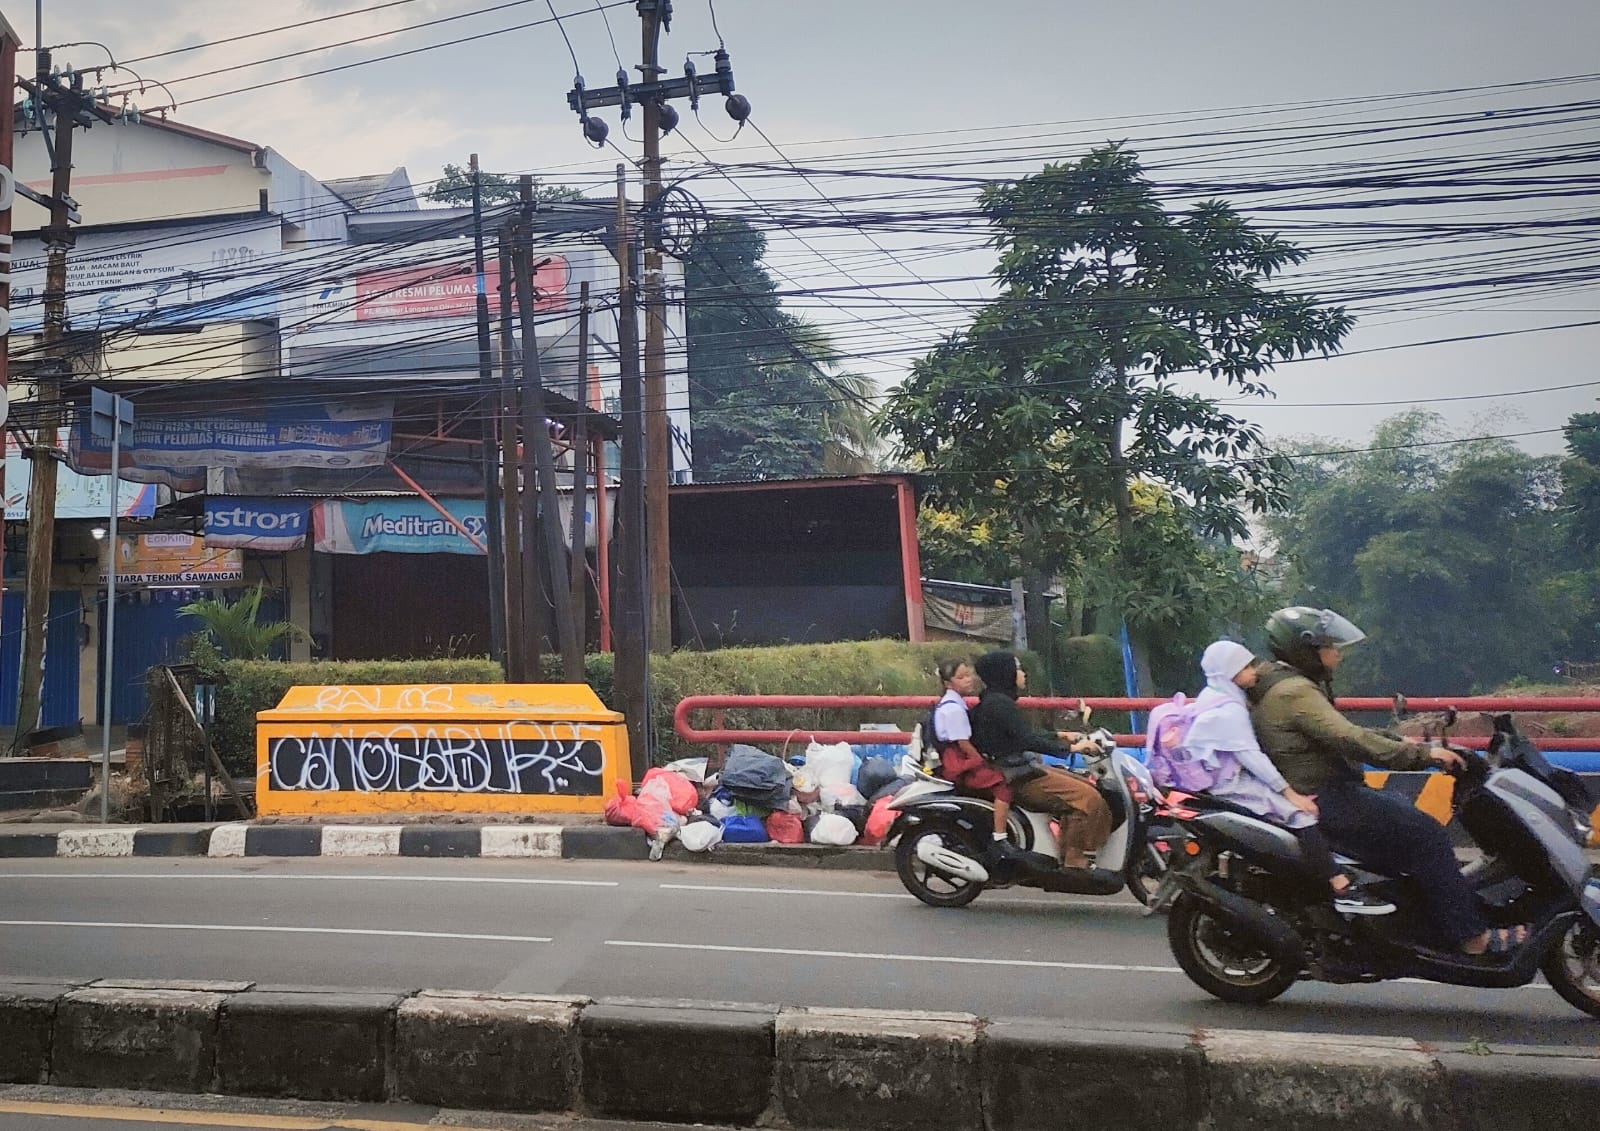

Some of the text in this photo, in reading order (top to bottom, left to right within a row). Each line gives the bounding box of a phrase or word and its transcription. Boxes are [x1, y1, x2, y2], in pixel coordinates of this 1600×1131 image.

[91, 263, 119, 271] MACAM
[143, 266, 175, 274] GYPSUM
[396, 285, 427, 298] RESMI
[428, 283, 478, 296] PELUMAS
[163, 432, 214, 445] PELUMAS
[215, 433, 276, 446] PERTAMINA
[361, 513, 459, 537] Meditran
[99, 571, 242, 584] MTIARA TEKNIK SAWANGAN
